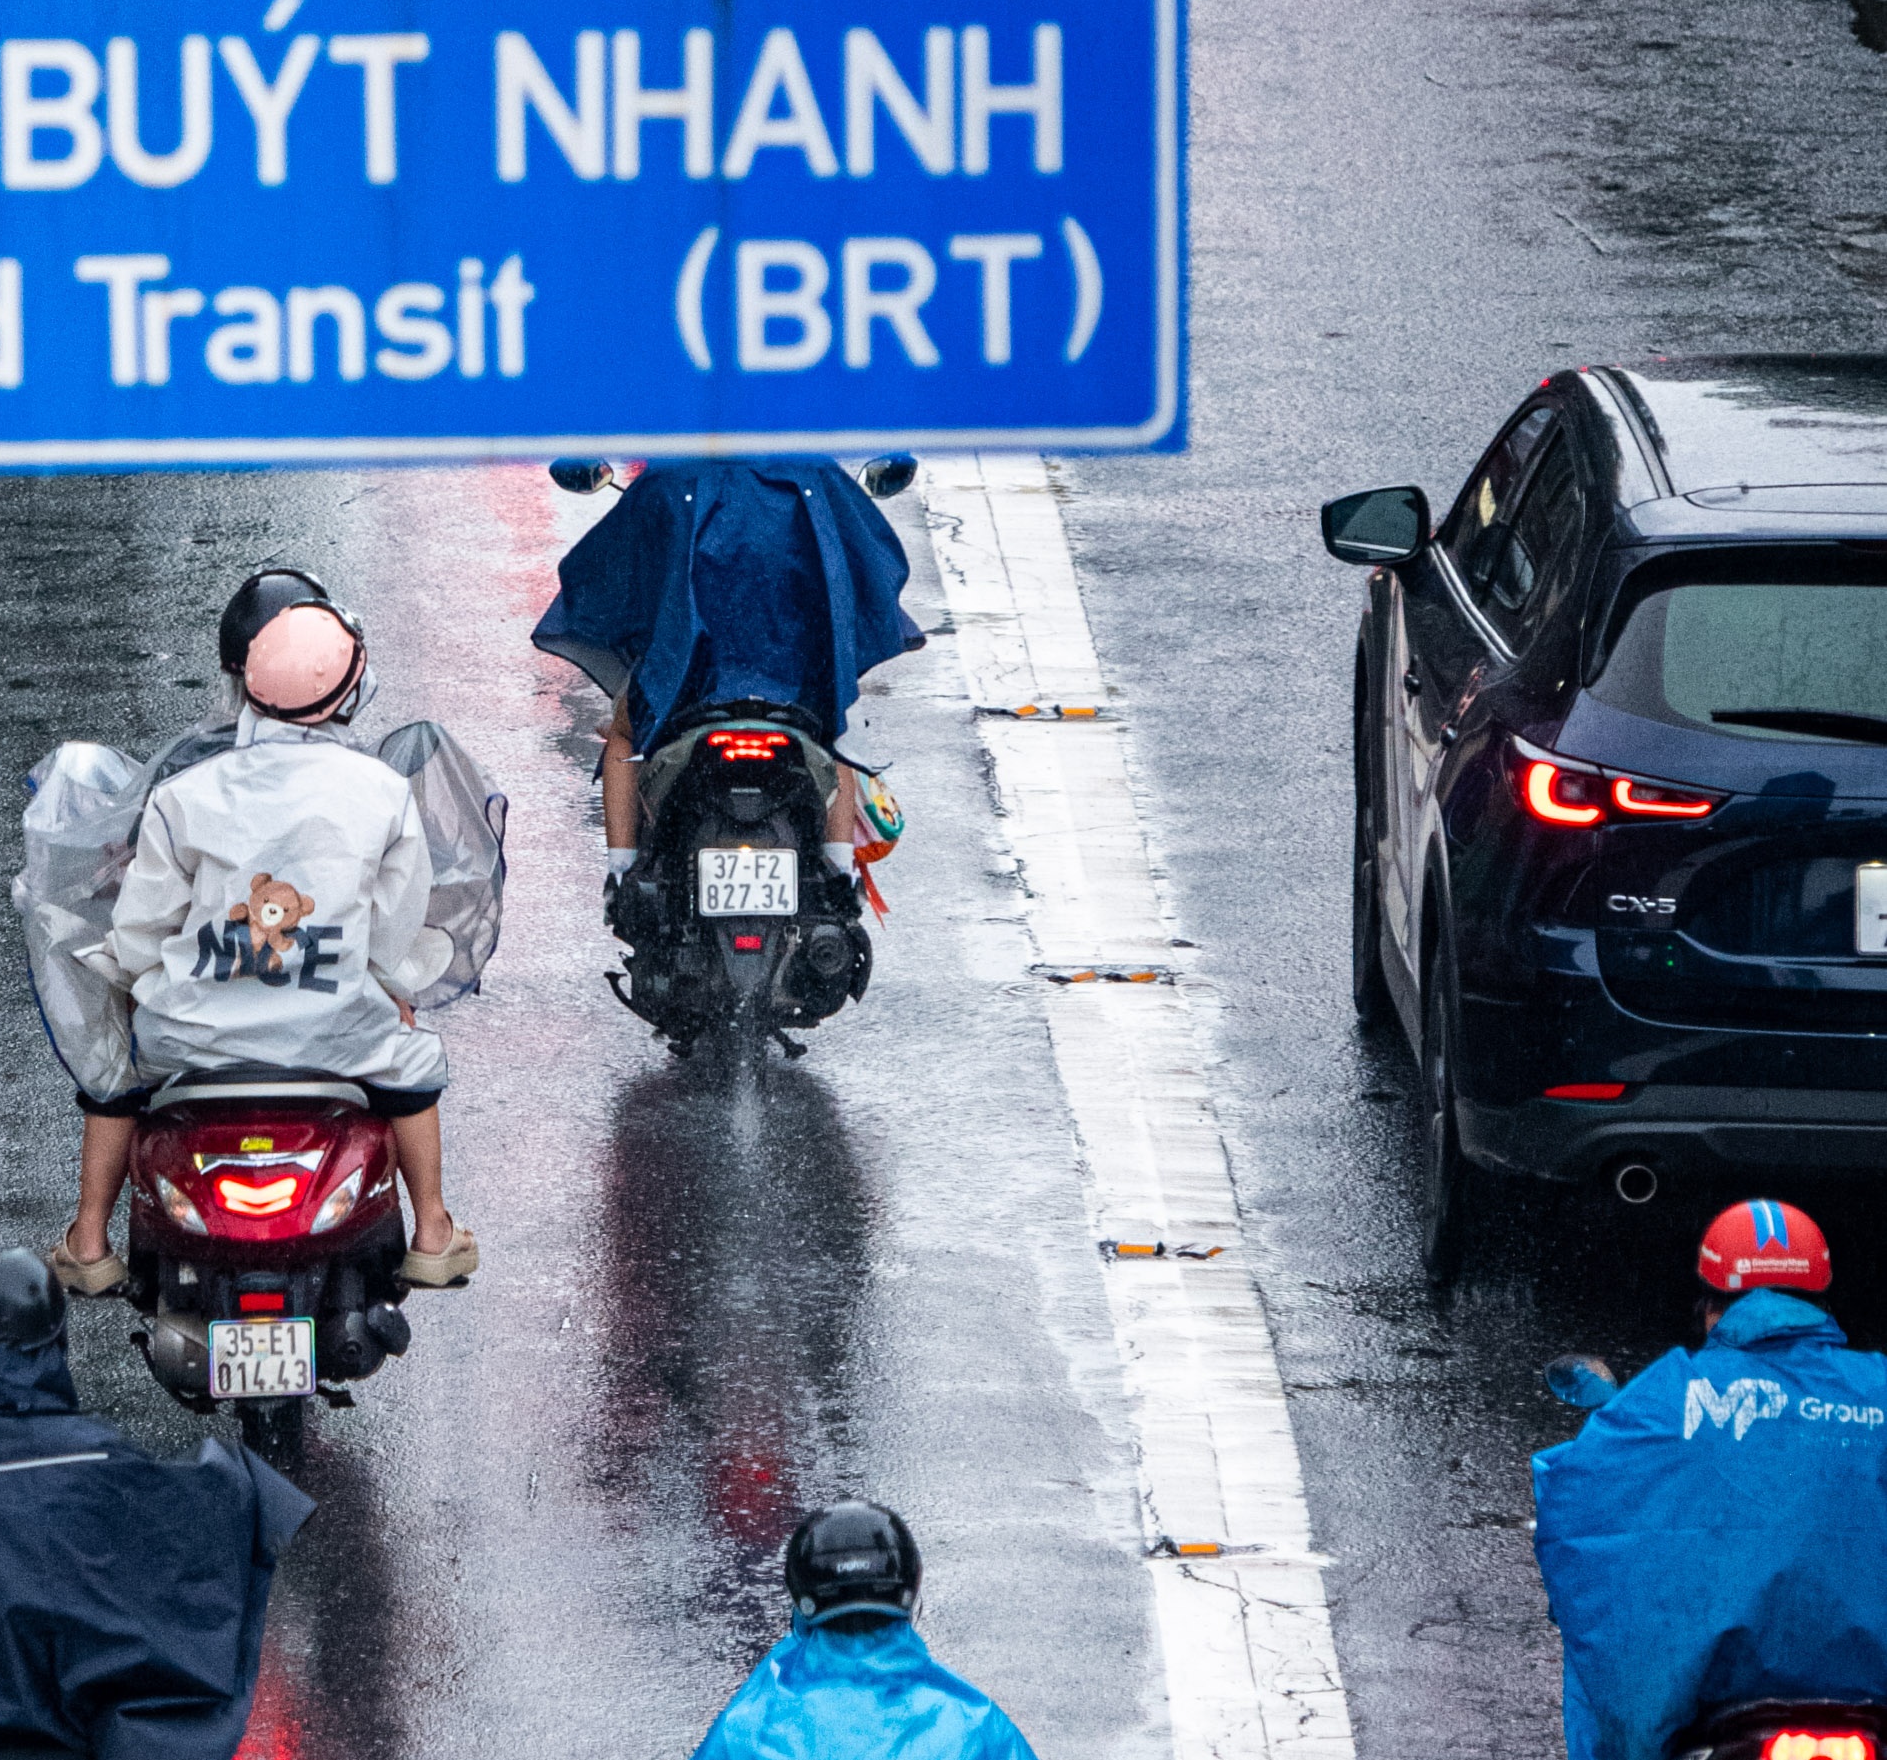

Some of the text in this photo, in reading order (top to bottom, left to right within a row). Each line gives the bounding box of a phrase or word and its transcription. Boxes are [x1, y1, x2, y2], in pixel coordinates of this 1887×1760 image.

[493, 23, 1065, 185] NHANH
[74, 252, 535, 389] Transit
[674, 215, 1105, 373] (BRT)
[713, 853, 781, 881] 37-F2
[706, 883, 790, 911] 827.34
[1607, 894, 1677, 914] CX-5
[225, 1324, 298, 1358] 35-E1
[217, 1358, 309, 1393] 014.43
[1799, 1396, 1885, 1432] Group
